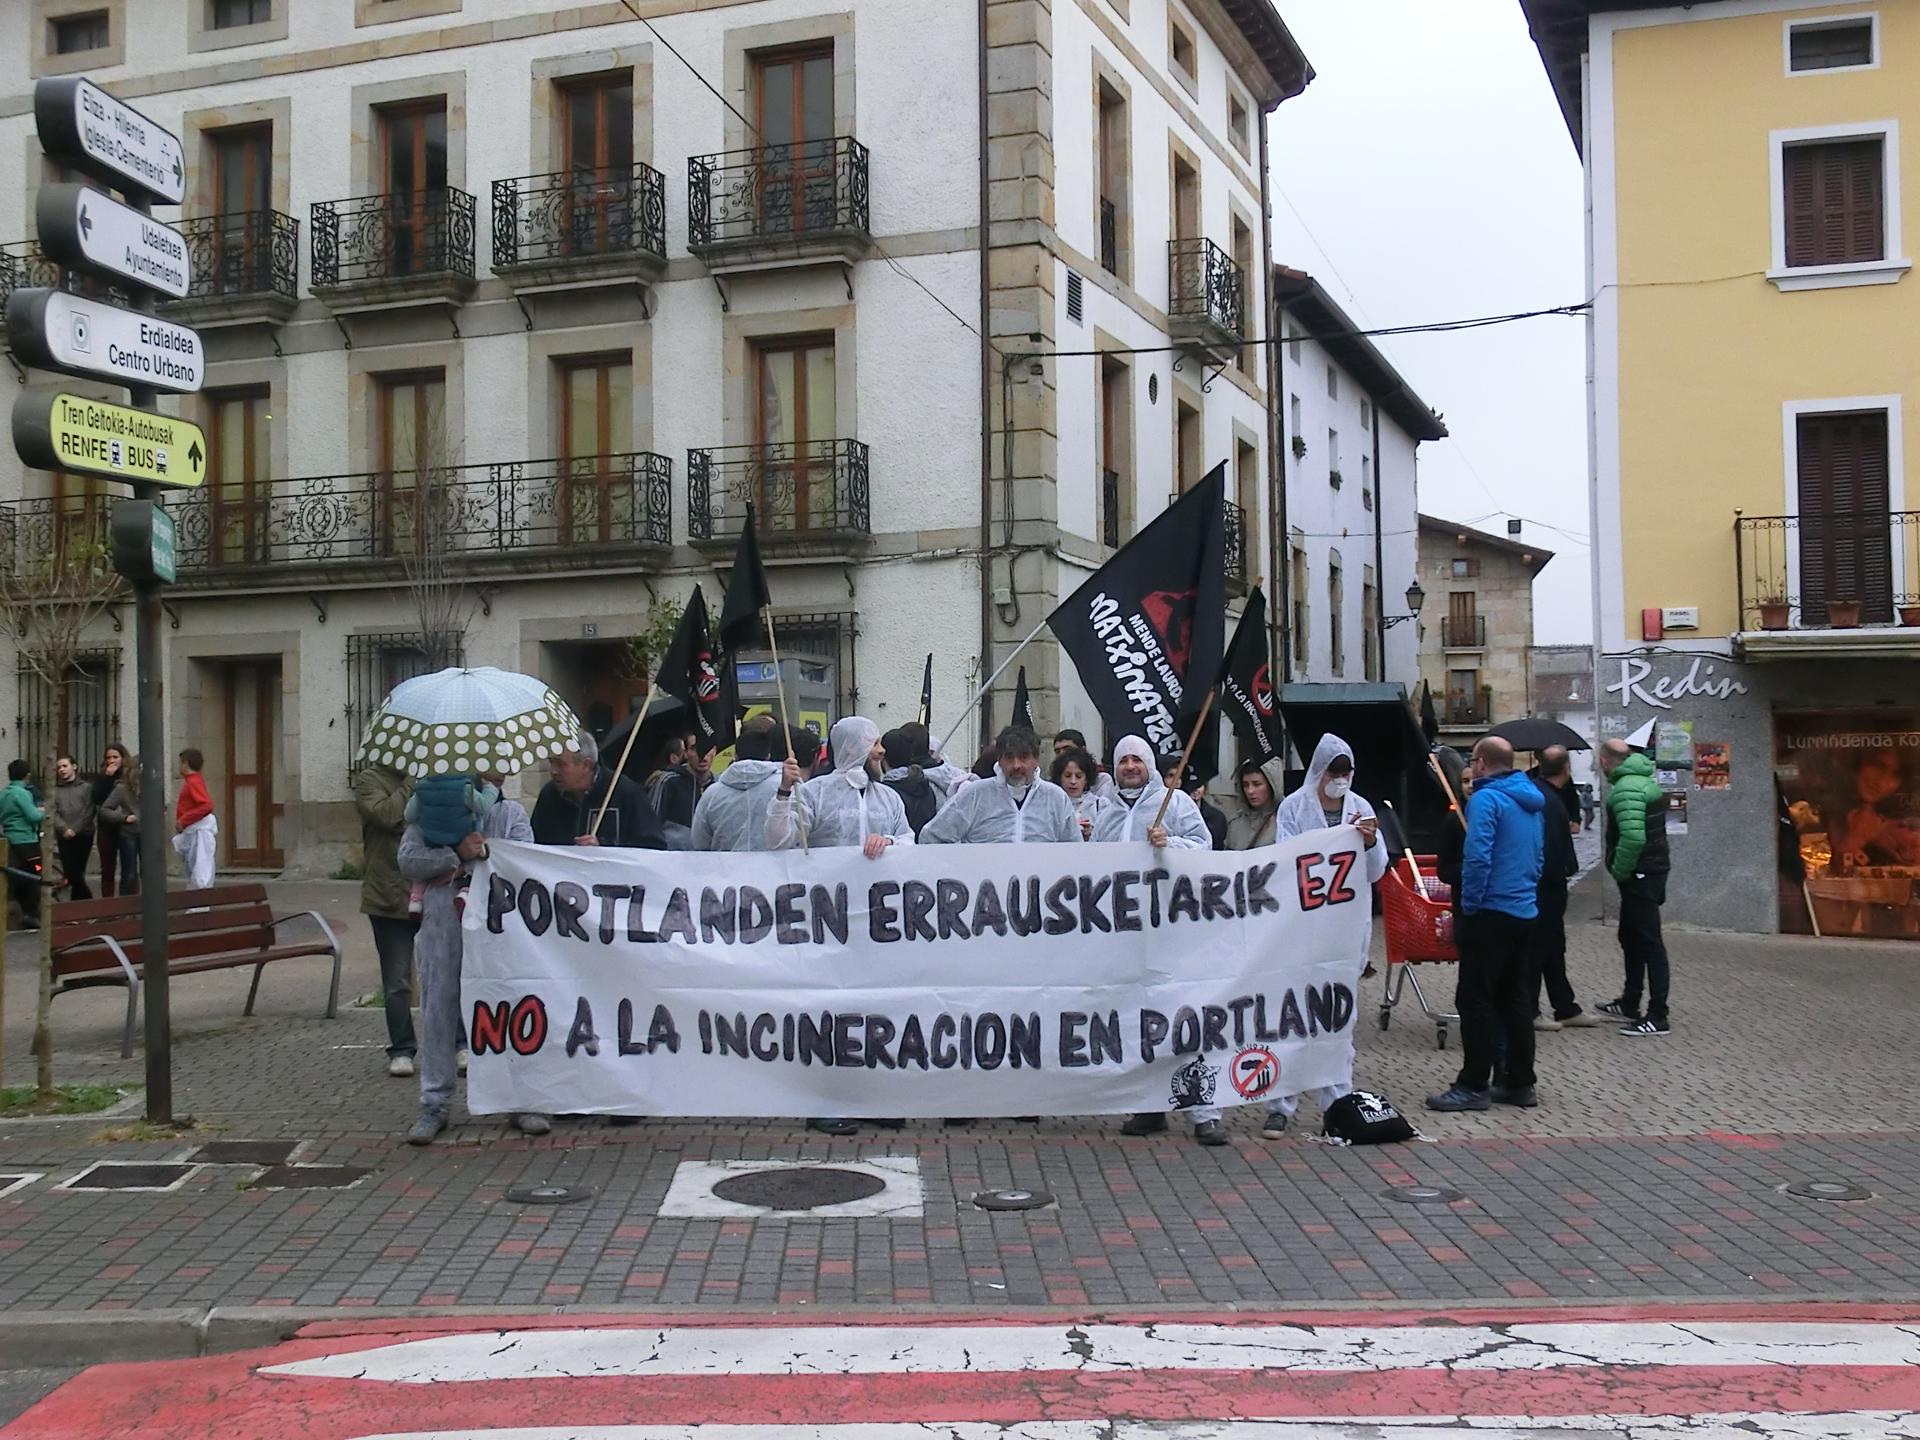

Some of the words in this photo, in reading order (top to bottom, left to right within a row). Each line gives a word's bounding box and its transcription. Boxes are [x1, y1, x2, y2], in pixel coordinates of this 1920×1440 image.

[83, 89, 105, 121] Eliza
[142, 223, 182, 261] Udaletxea
[125, 245, 183, 288] Ayuntamiento
[140, 323, 194, 355] Erdialdea
[109, 344, 150, 373] Centro
[153, 354, 195, 383] Urbano
[61, 399, 85, 426] Tren
[61, 432, 108, 462] RENFE
[128, 446, 154, 469] BUS
[1128, 613, 1162, 658] MENDE
[1234, 689, 1247, 703] LA
[1606, 657, 1748, 709] Redin
[487, 872, 849, 945] PORTLANDEN
[868, 860, 1281, 943] ERRAUSKETARIK
[1296, 850, 1356, 911] EZ
[471, 994, 548, 1056] NO
[566, 996, 600, 1058] A
[618, 998, 681, 1056] LA
[698, 1008, 1043, 1071] INCINERACION
[1060, 1008, 1123, 1067] EN
[1140, 981, 1355, 1064] PORTLAND
